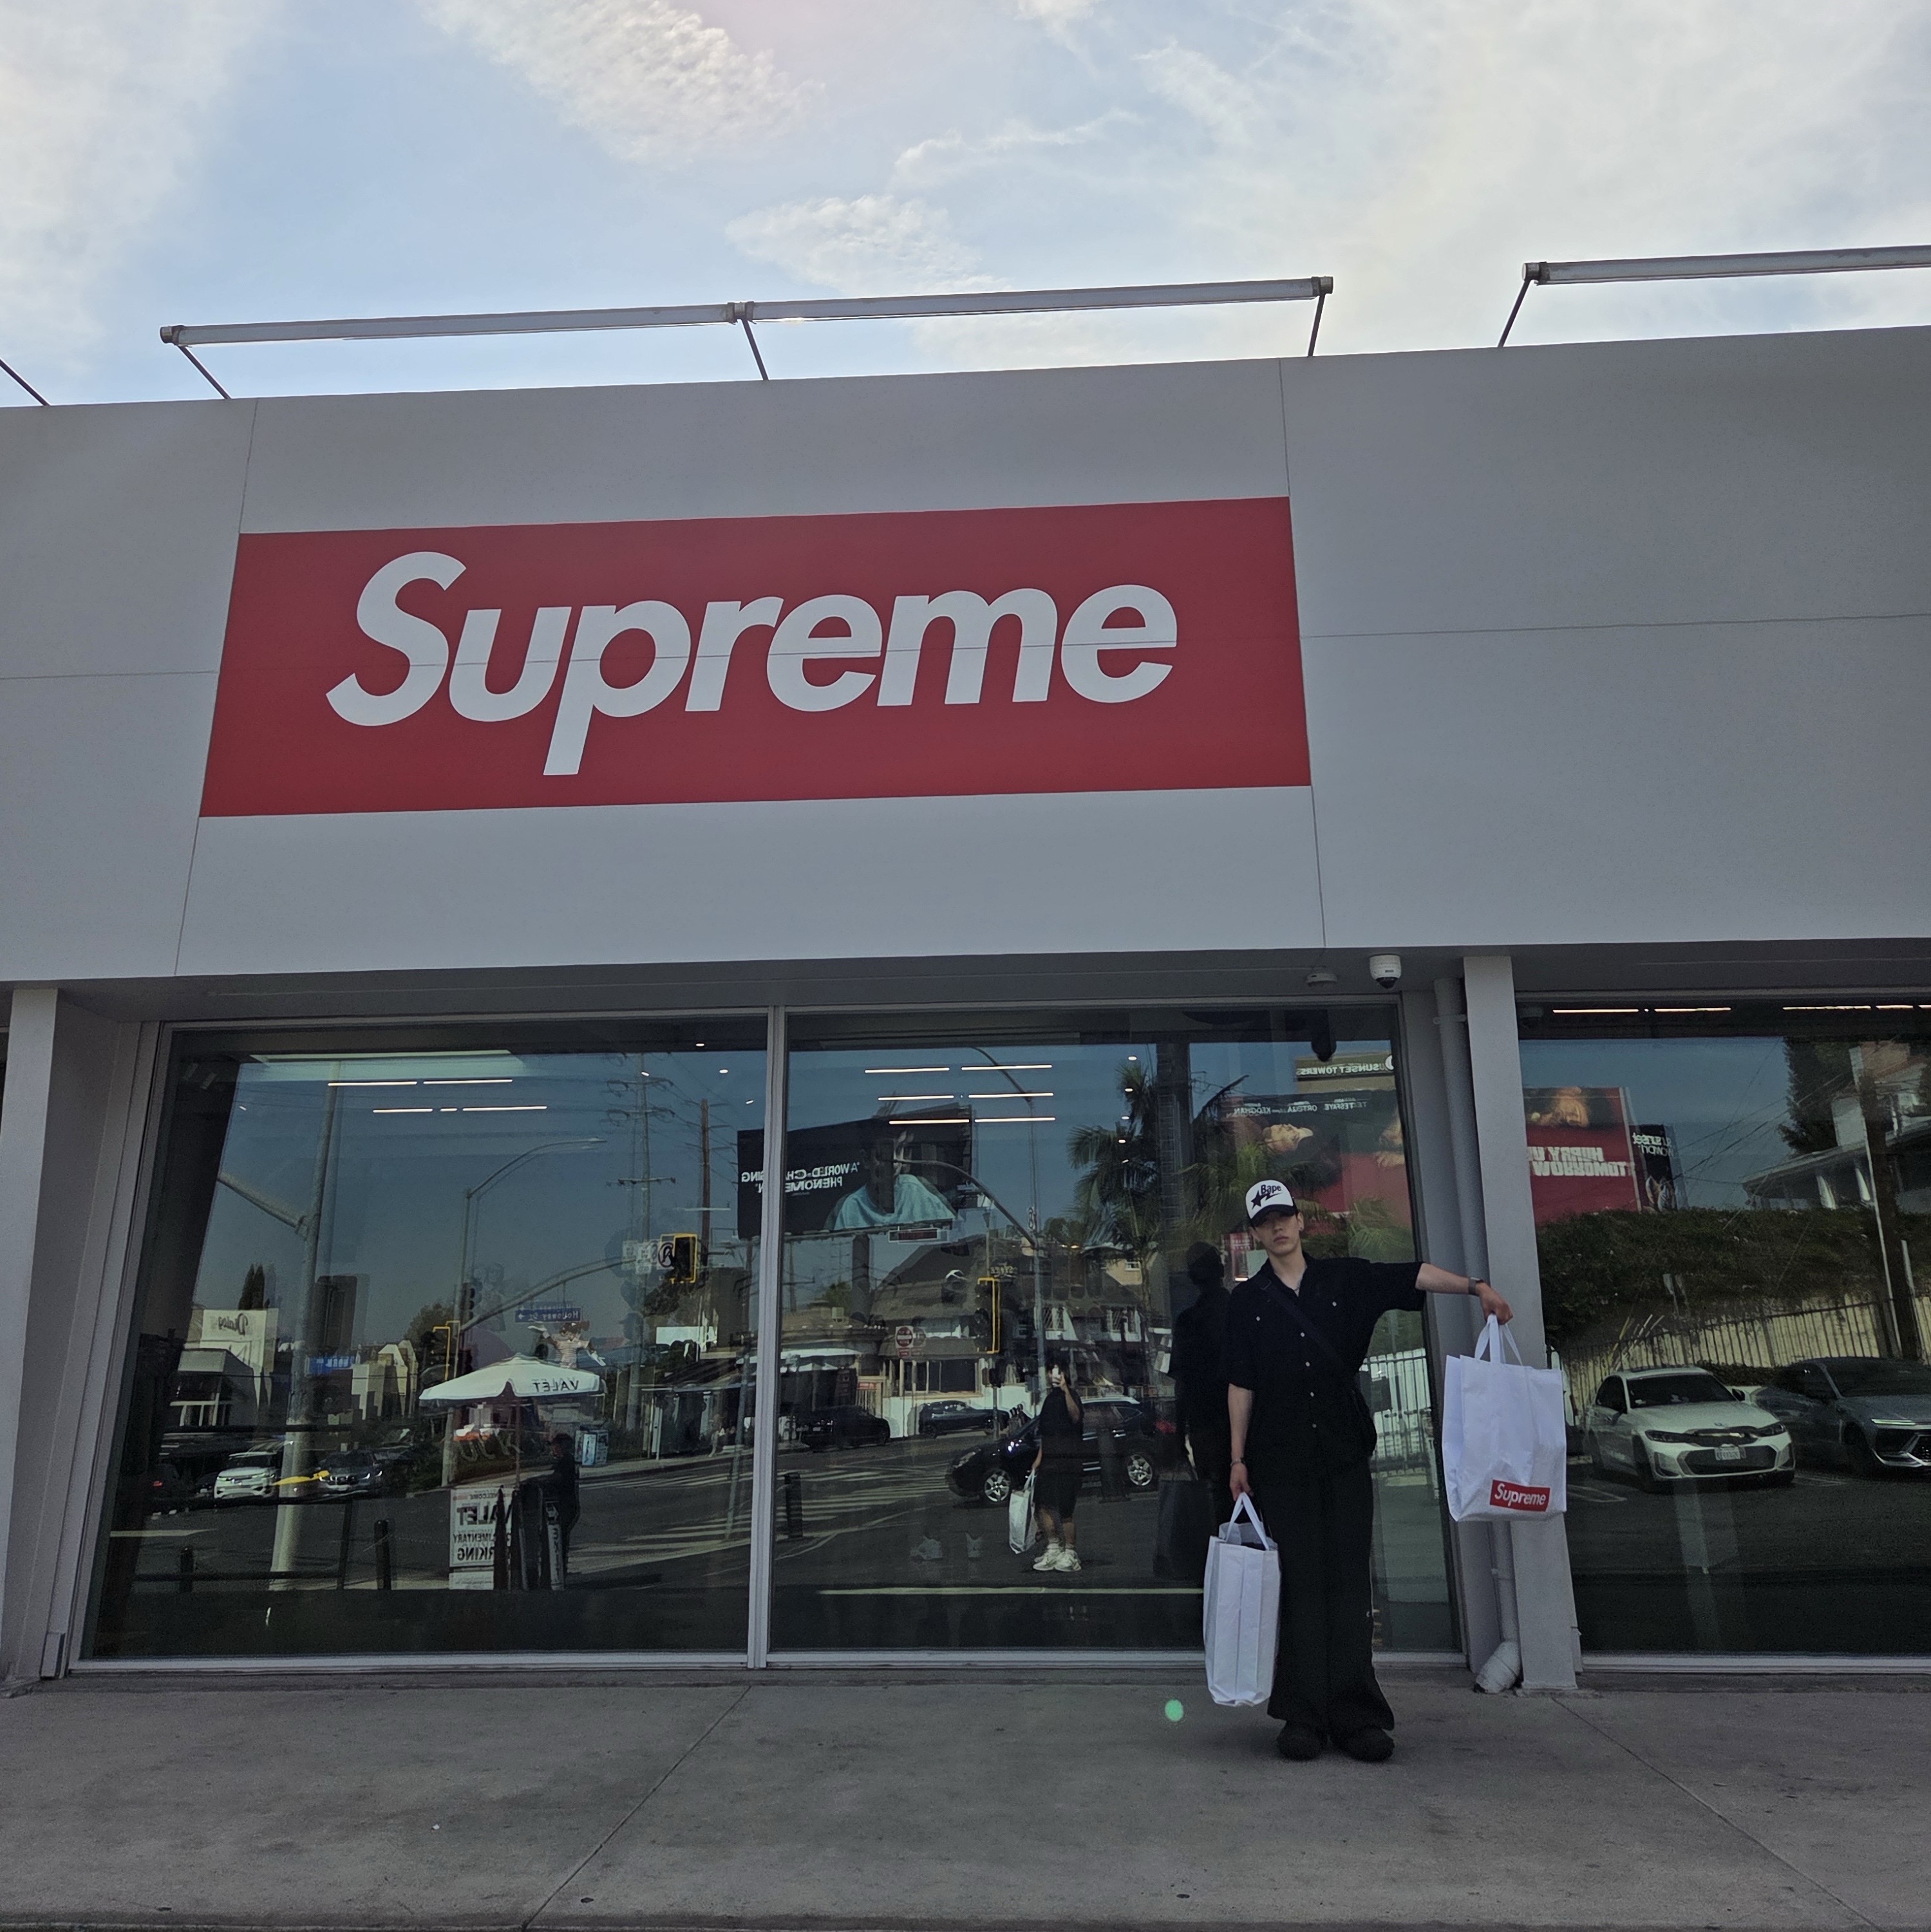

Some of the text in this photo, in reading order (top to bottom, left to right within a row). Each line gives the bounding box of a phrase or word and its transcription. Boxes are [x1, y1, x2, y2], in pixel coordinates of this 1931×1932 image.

[325, 551, 1178, 776] Supreme
[1261, 1184, 1282, 1194] Bape
[1494, 1483, 1547, 1506] Supreme
